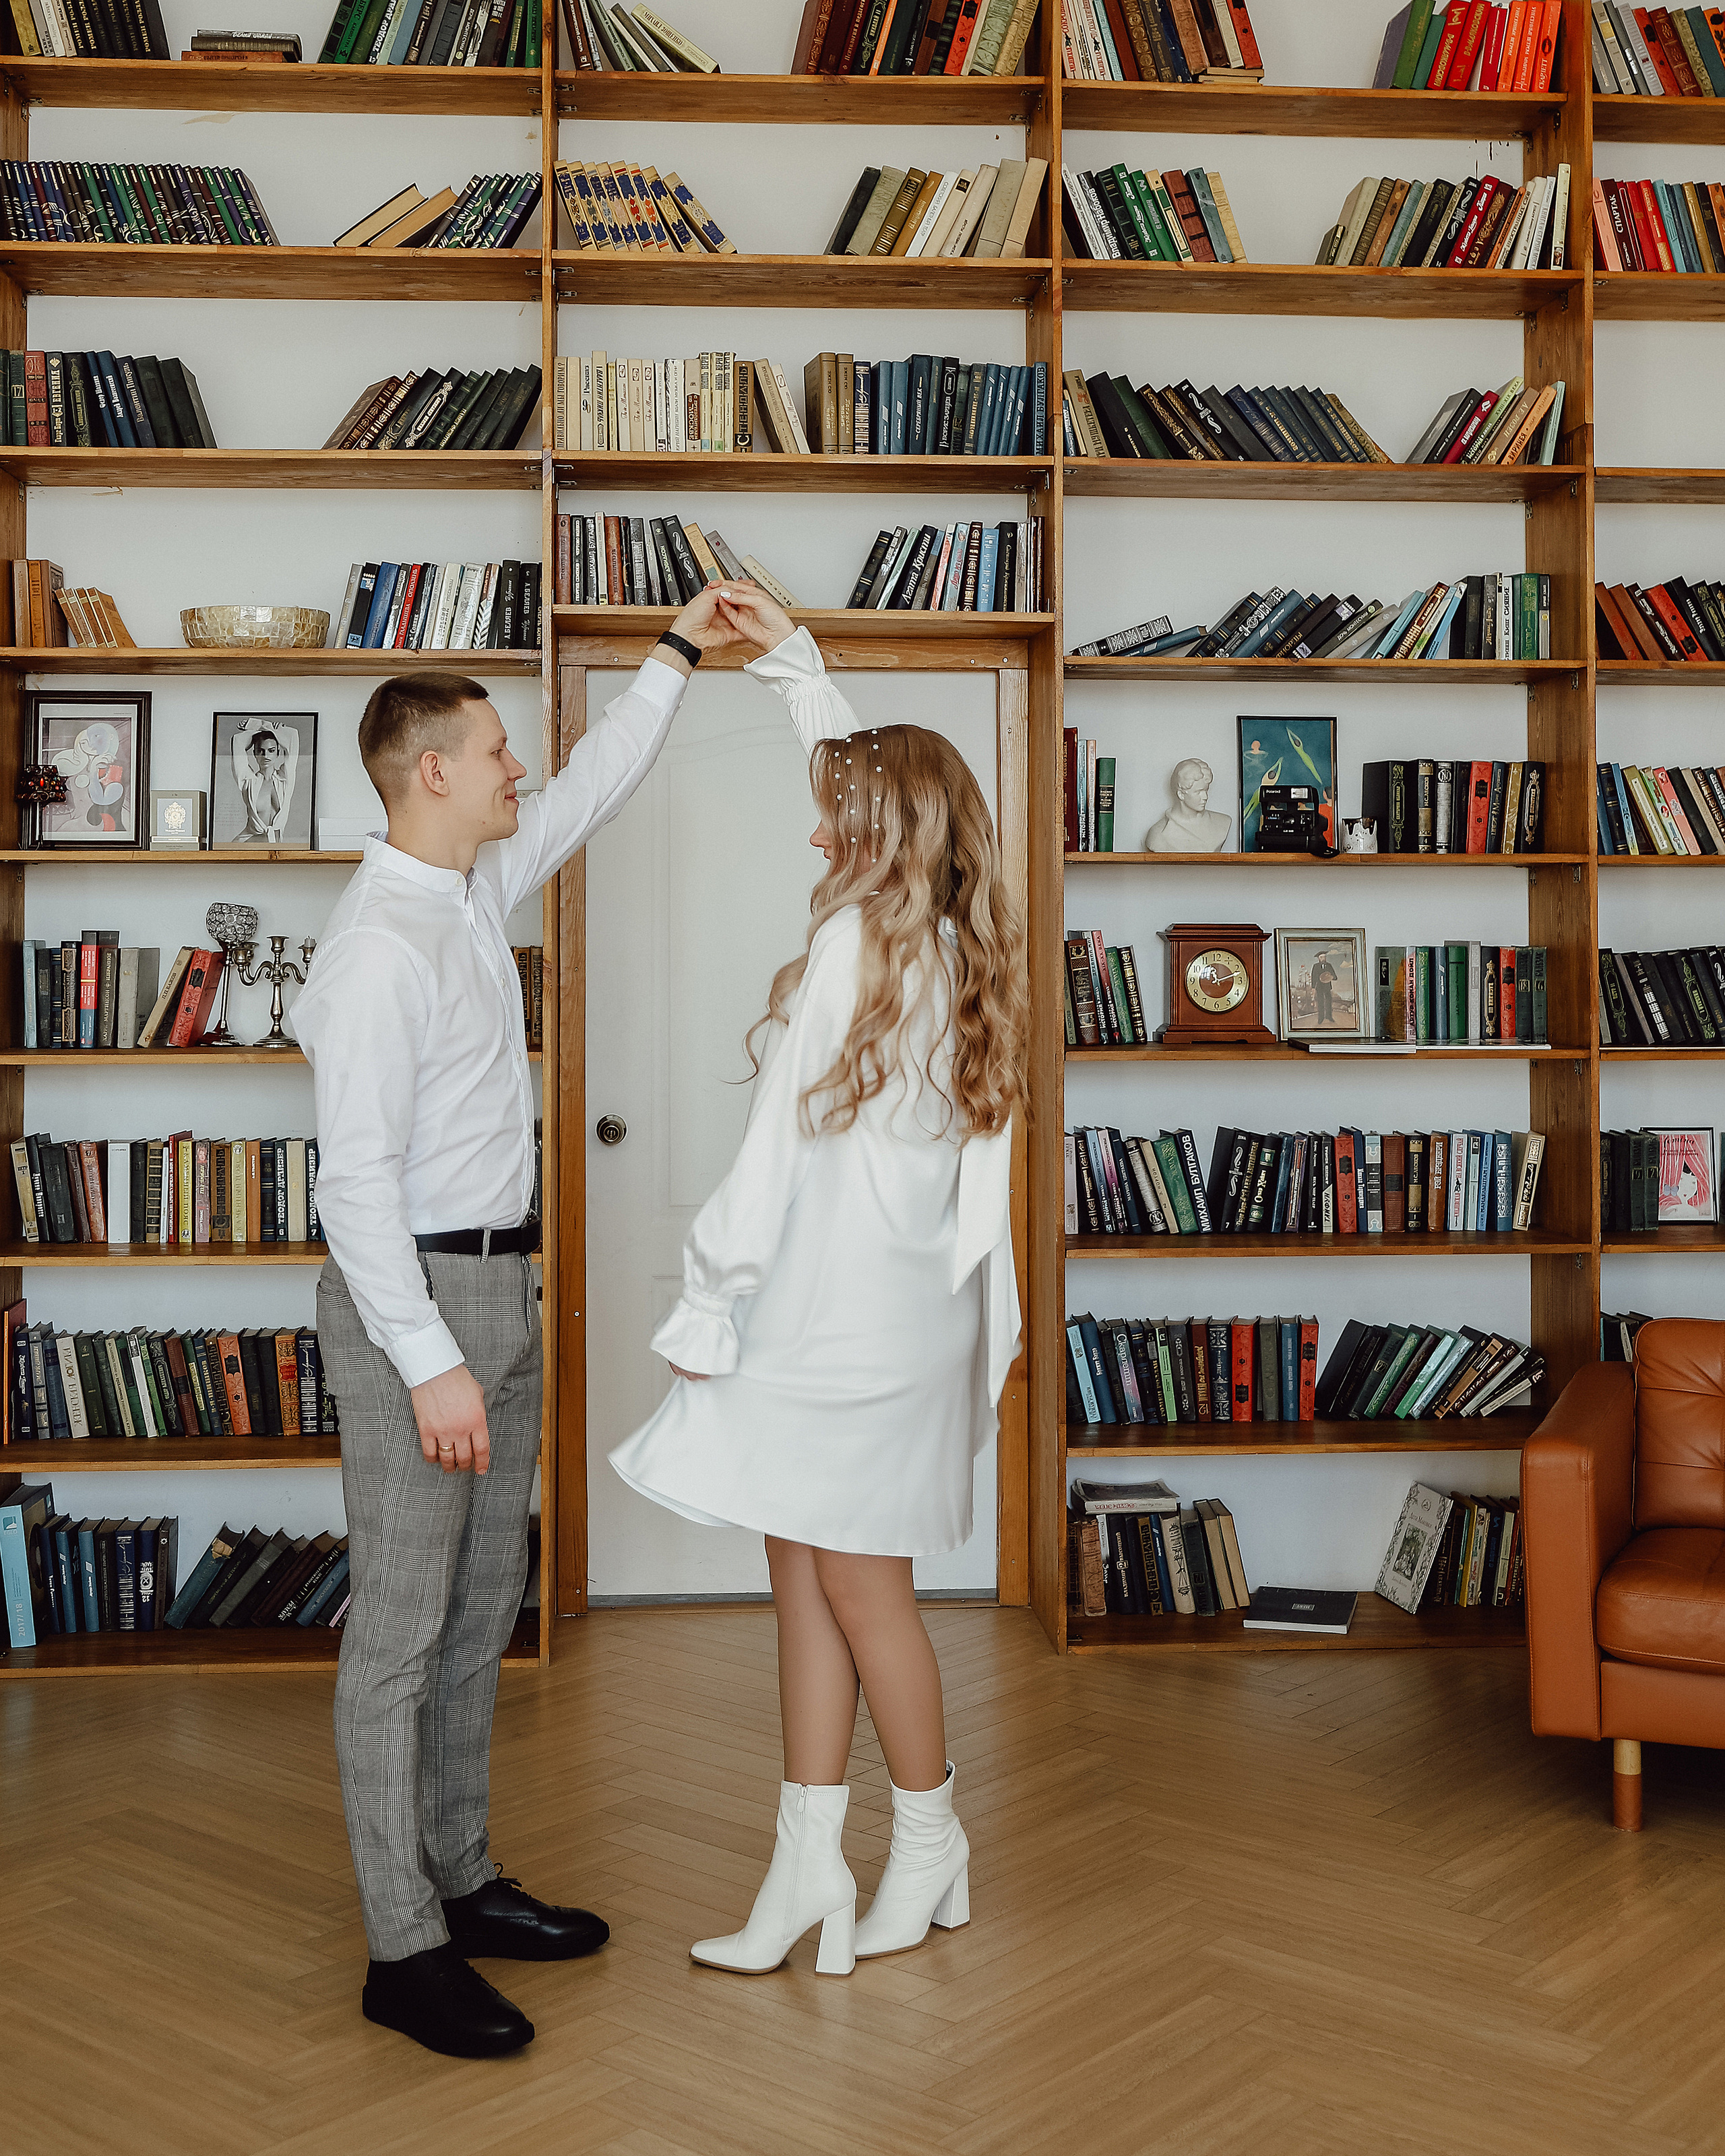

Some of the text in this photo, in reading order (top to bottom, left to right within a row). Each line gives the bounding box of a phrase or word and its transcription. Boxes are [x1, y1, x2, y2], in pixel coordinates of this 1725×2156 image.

[373, 20, 388, 52] ТЕОДОР
[844, 28, 857, 61] Психология
[1089, 188, 1121, 259] Владимир Набоков
[1609, 194, 1623, 232] СПАРТАК
[51, 369, 61, 402] ЕВГЕНИЯ
[123, 362, 145, 422] Валентин Пикуль
[557, 362, 565, 393] ГОВОРИМ?
[557, 395, 565, 405] МЫ
[736, 367, 750, 445] СТЕНДАЛЬ
[915, 399, 923, 433] СЕРЕБРЯНЫЙ
[1036, 367, 1046, 455] МИХАИЛ БУЛГАКОВ
[557, 416, 565, 448] ПРАВИЛЬНО
[941, 419, 950, 441] БОРИС
[1507, 432, 1528, 460] ВИРИНЕЯ
[902, 533, 931, 604] Агата Кристи
[398, 569, 418, 635] ГЛАДЫШЕВА ОПОЛЗЕНЬ
[410, 614, 419, 634] Сонник
[504, 607, 512, 639] А.БЕЛЯЕВ
[1182, 1134, 1212, 1232] МИХАИЛ БУЛГАКОВ
[1434, 1141, 1444, 1190] РЭЙ БРЭДБЕРИ
[277, 1147, 286, 1224] ТЕОДОР ДРАЙЗЕР
[1480, 1169, 1488, 1213] МАНДЕЛЬШТАМ
[64, 1346, 83, 1427] ЖЕНСКАЯ ЛОГИКА
